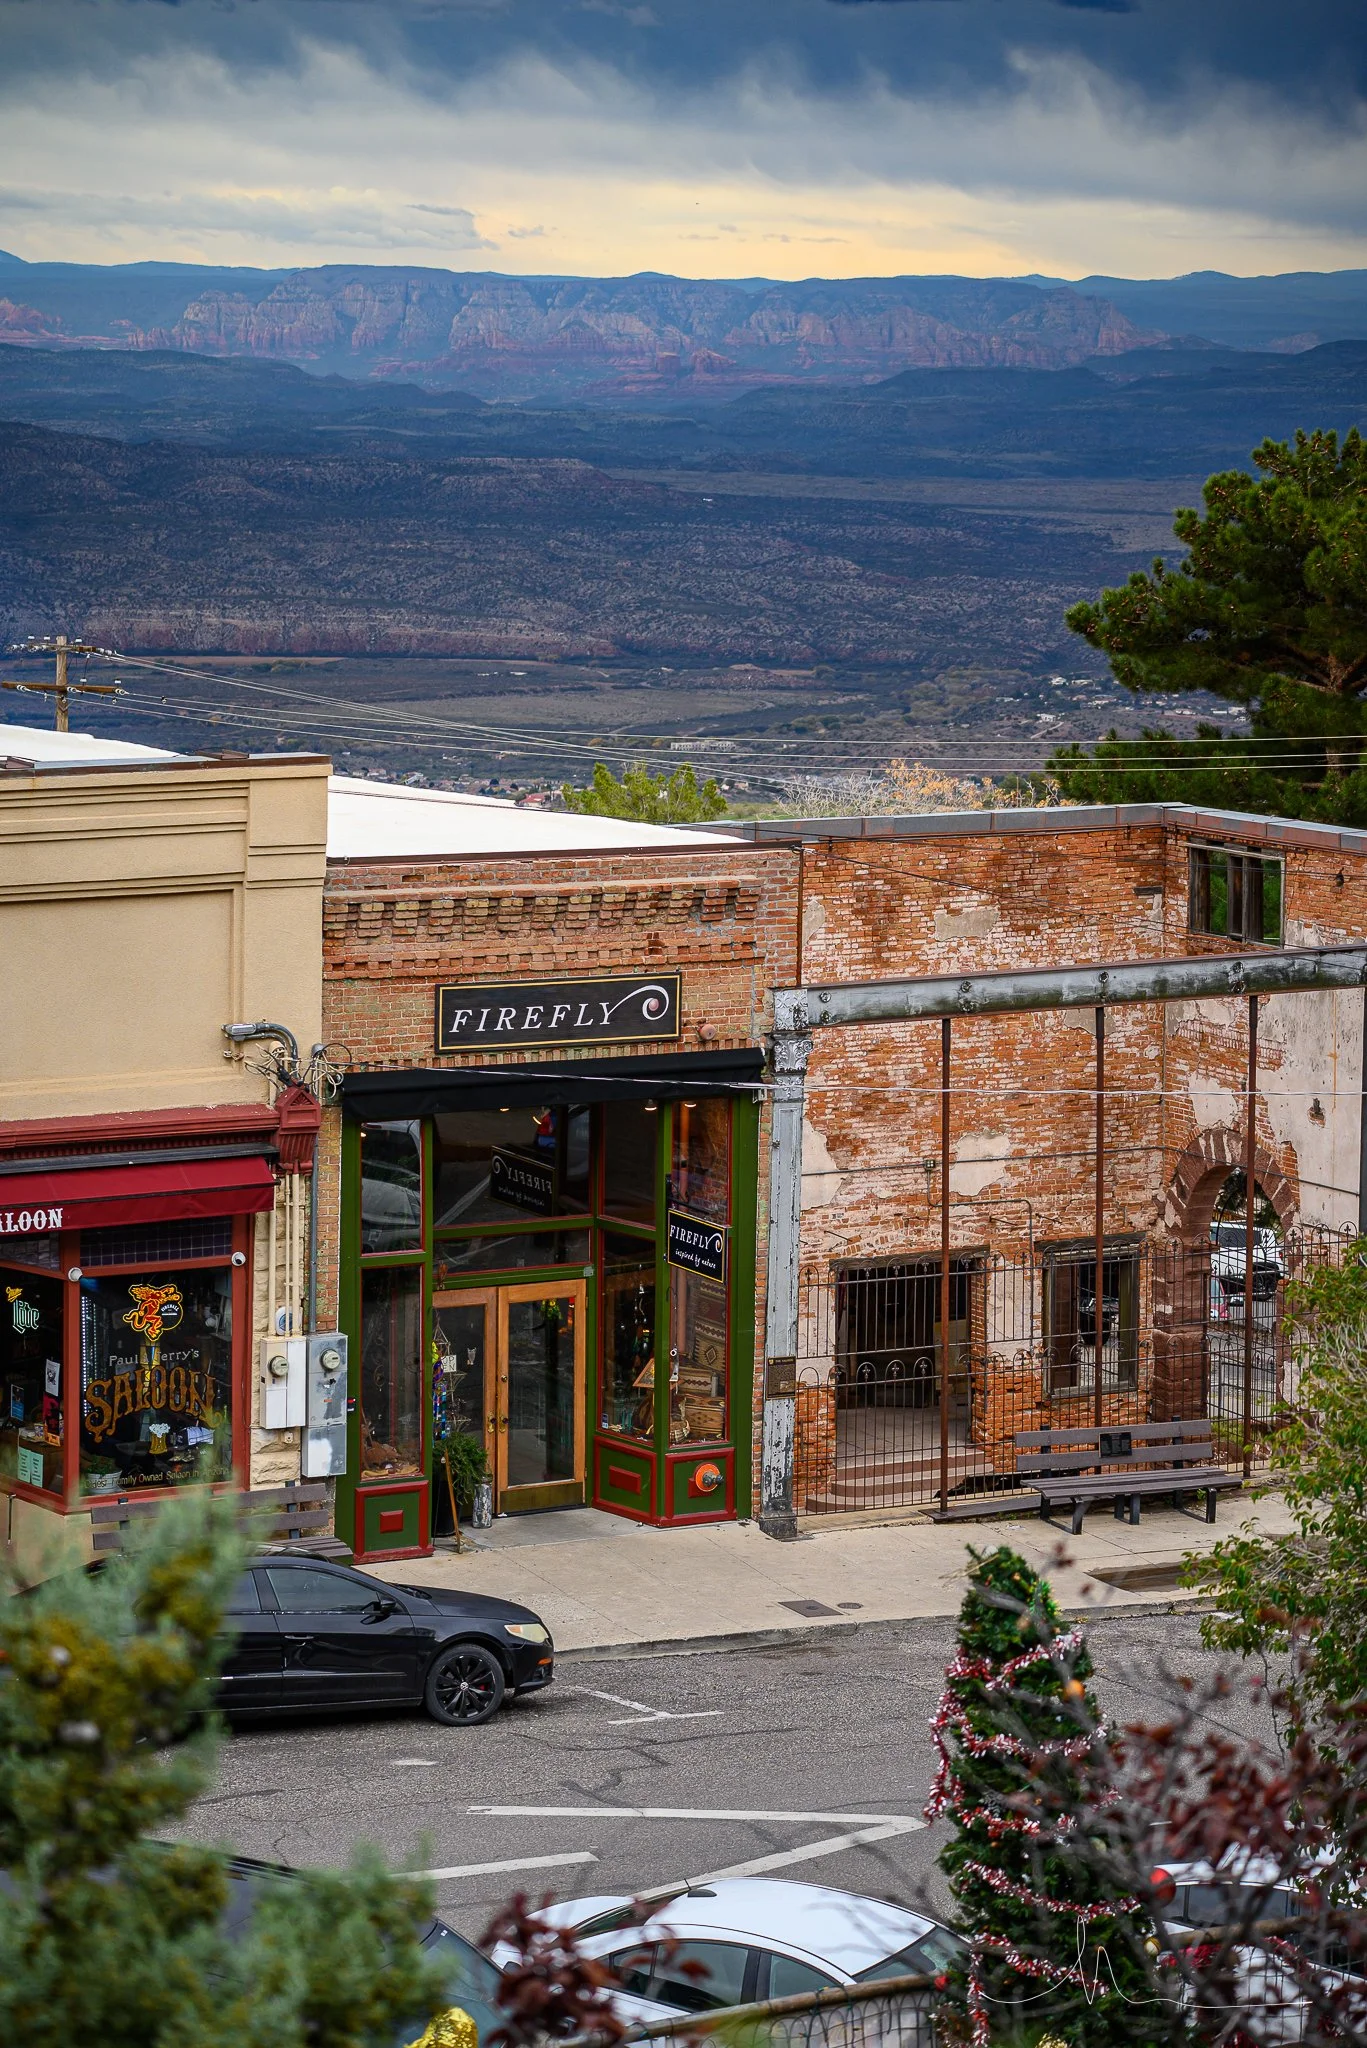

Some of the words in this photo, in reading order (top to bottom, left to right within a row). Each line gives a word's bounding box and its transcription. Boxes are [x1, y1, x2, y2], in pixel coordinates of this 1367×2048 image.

[449, 991, 636, 1032] FIREFLY
[670, 1225, 721, 1251] FIREFLY
[675, 1248, 694, 1260] inspired
[695, 1254, 701, 1267] by
[702, 1259, 716, 1269] nature
[109, 1354, 138, 1366] Paul
[85, 1365, 222, 1442] SALOON
[139, 1472, 162, 1482] Owned
